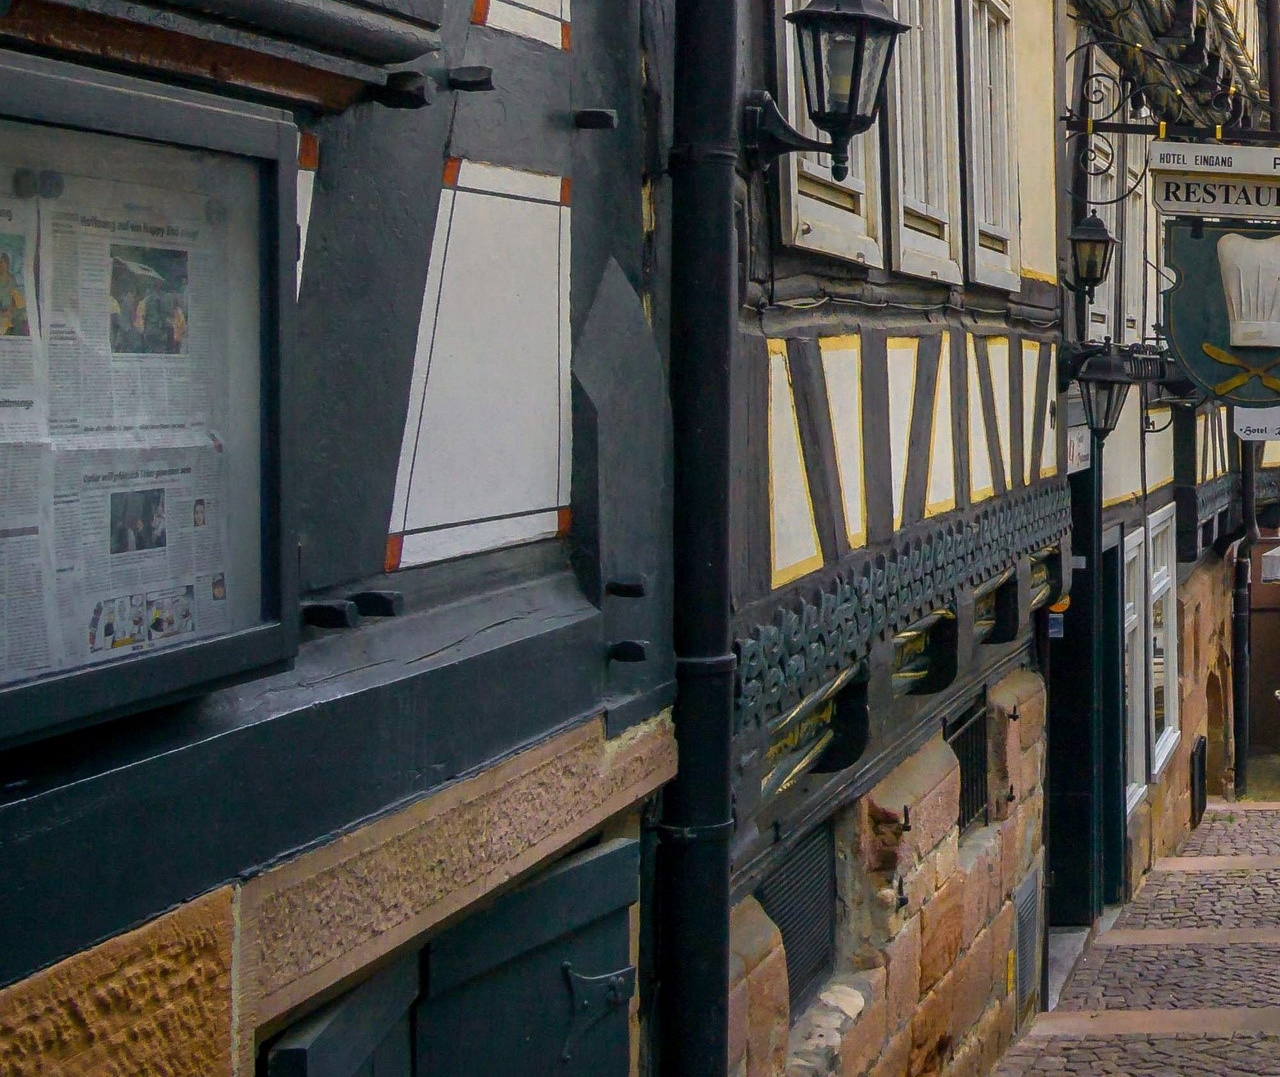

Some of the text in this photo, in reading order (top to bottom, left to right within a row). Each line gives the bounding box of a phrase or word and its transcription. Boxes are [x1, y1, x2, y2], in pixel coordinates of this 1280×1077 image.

[1159, 152, 1233, 168] HOTEL EINGANG
[1243, 425, 1267, 436] Hotel
